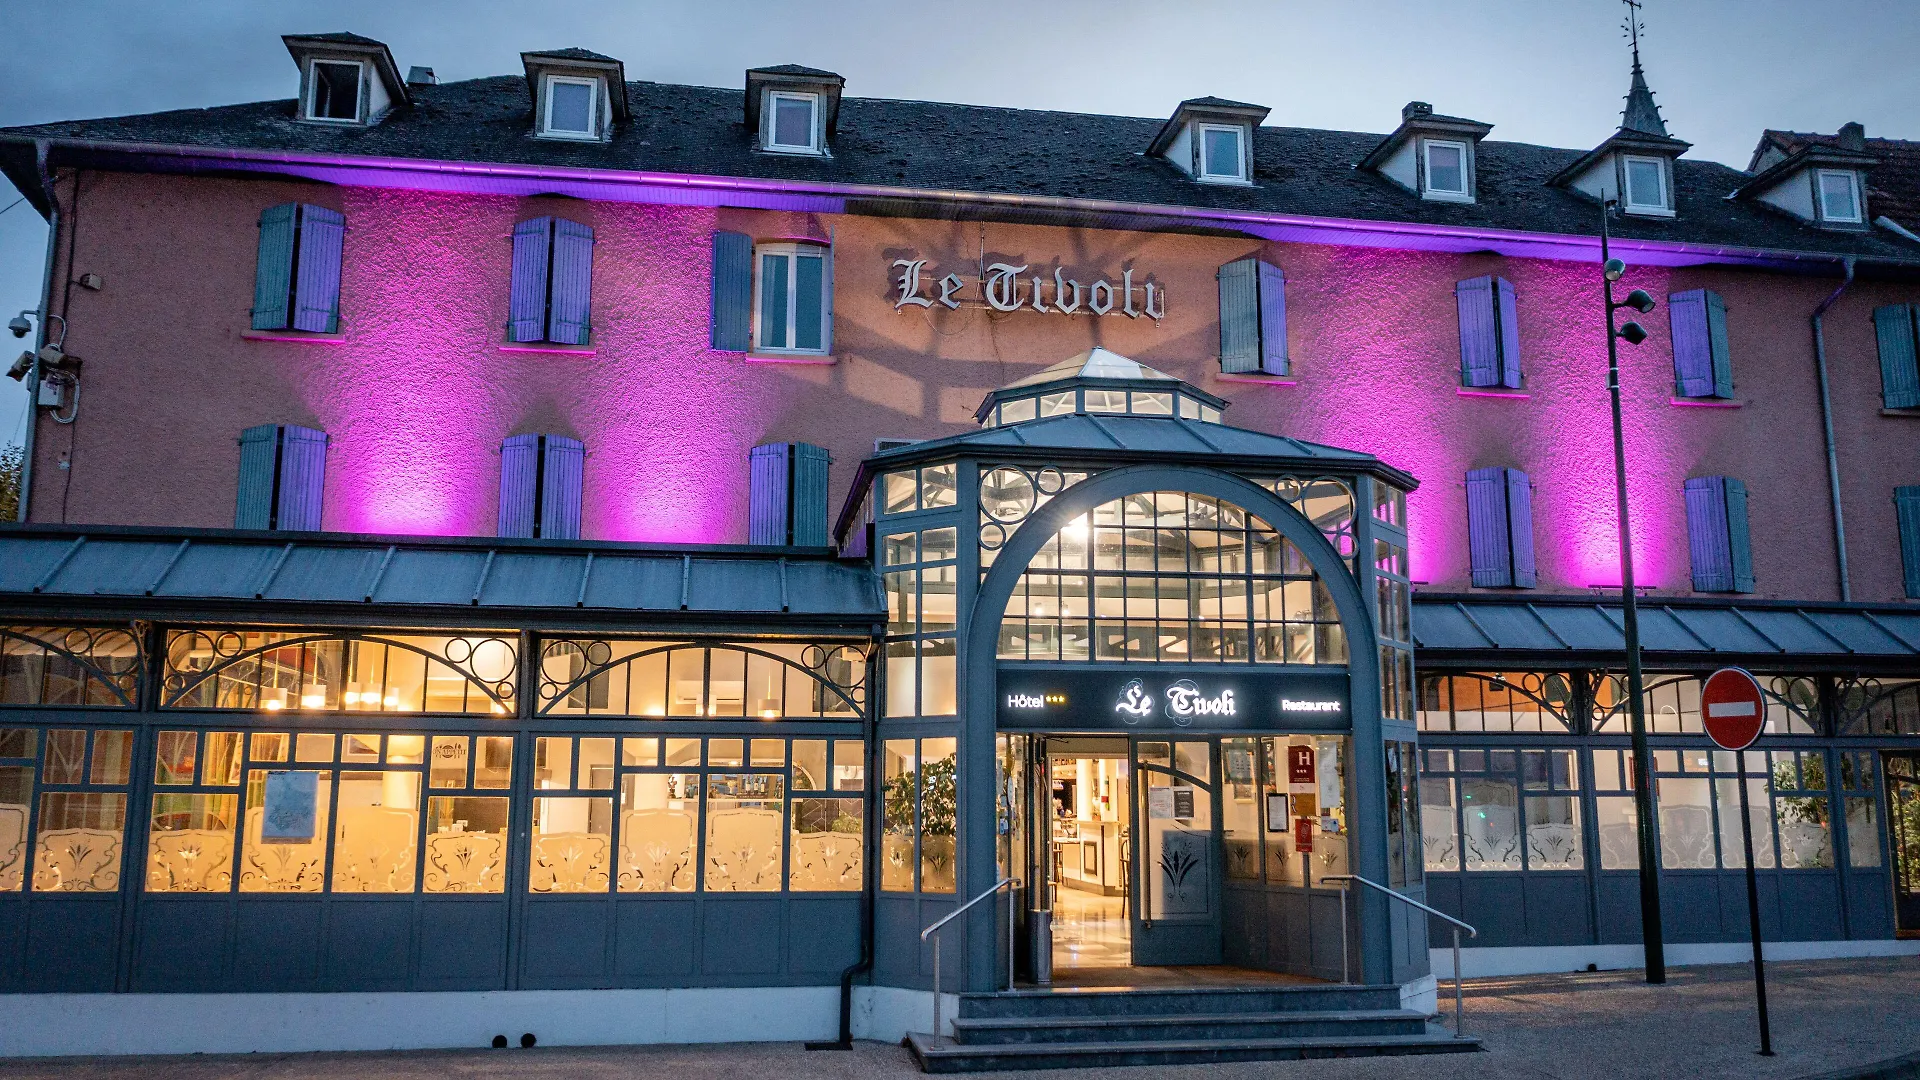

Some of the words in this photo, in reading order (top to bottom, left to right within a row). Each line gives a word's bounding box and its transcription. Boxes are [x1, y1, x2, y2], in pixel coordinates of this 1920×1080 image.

[892, 259, 964, 310] Le
[985, 262, 1164, 320] Tivoli
[1008, 694, 1044, 708] Hôtel
[1115, 683, 1152, 717] Le
[1166, 685, 1237, 716] Tivoli
[1282, 699, 1341, 711] Restaurant
[1298, 751, 1311, 766] H
